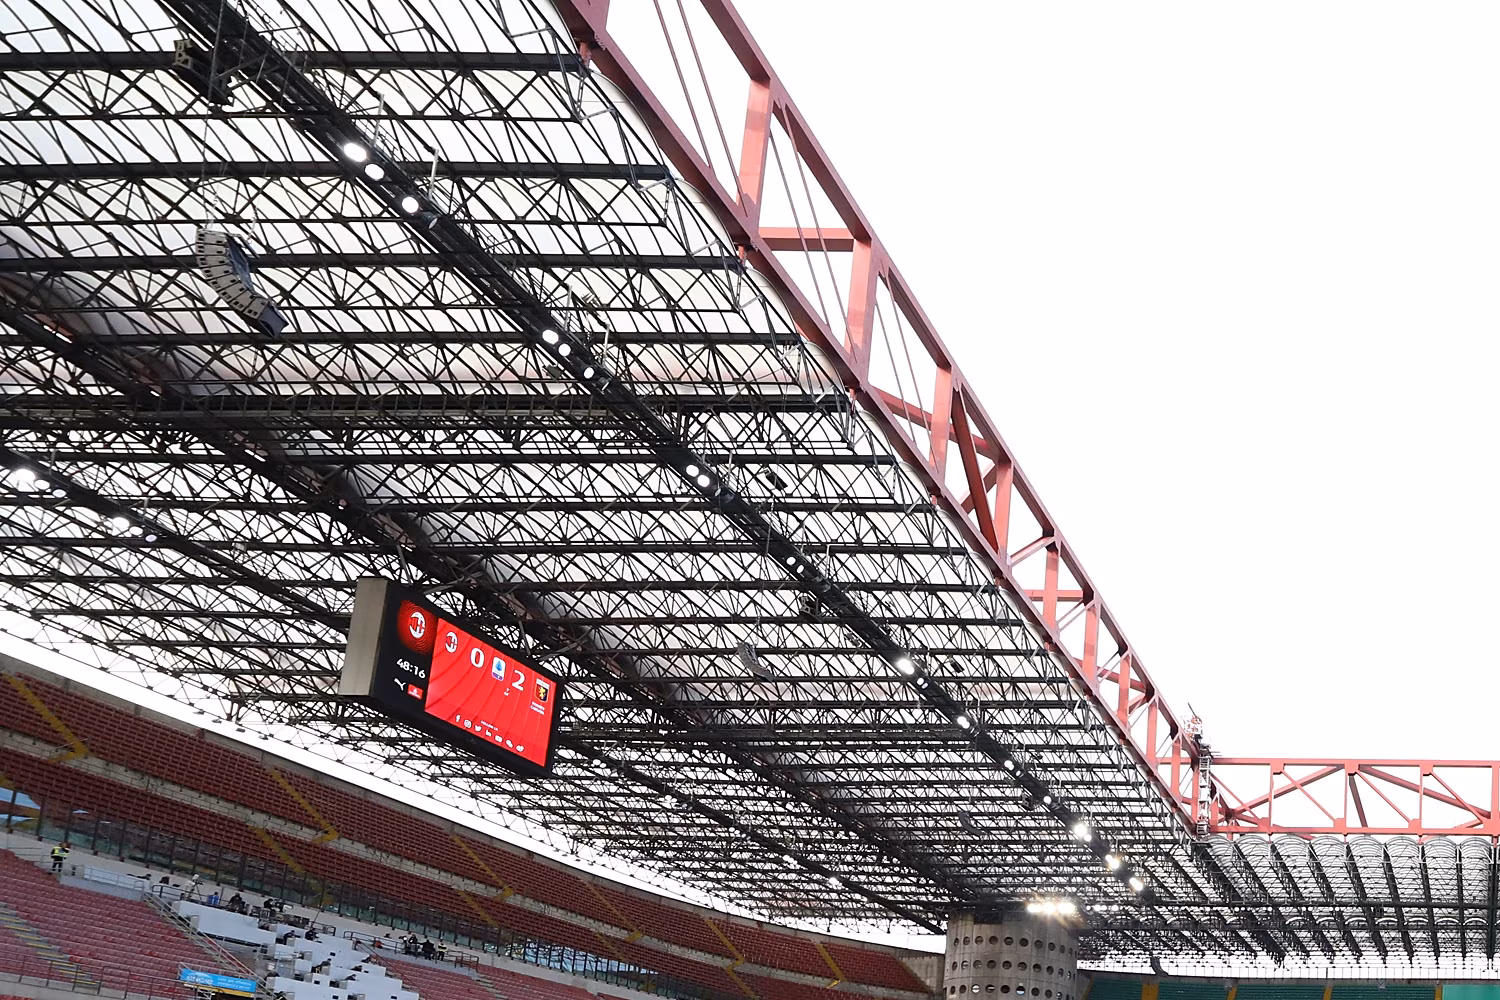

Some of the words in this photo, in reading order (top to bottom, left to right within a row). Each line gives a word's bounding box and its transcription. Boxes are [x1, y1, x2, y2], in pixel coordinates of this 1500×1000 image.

[470, 647, 485, 668] 0
[396, 658, 426, 679] 48:16
[511, 669, 526, 692] 2
